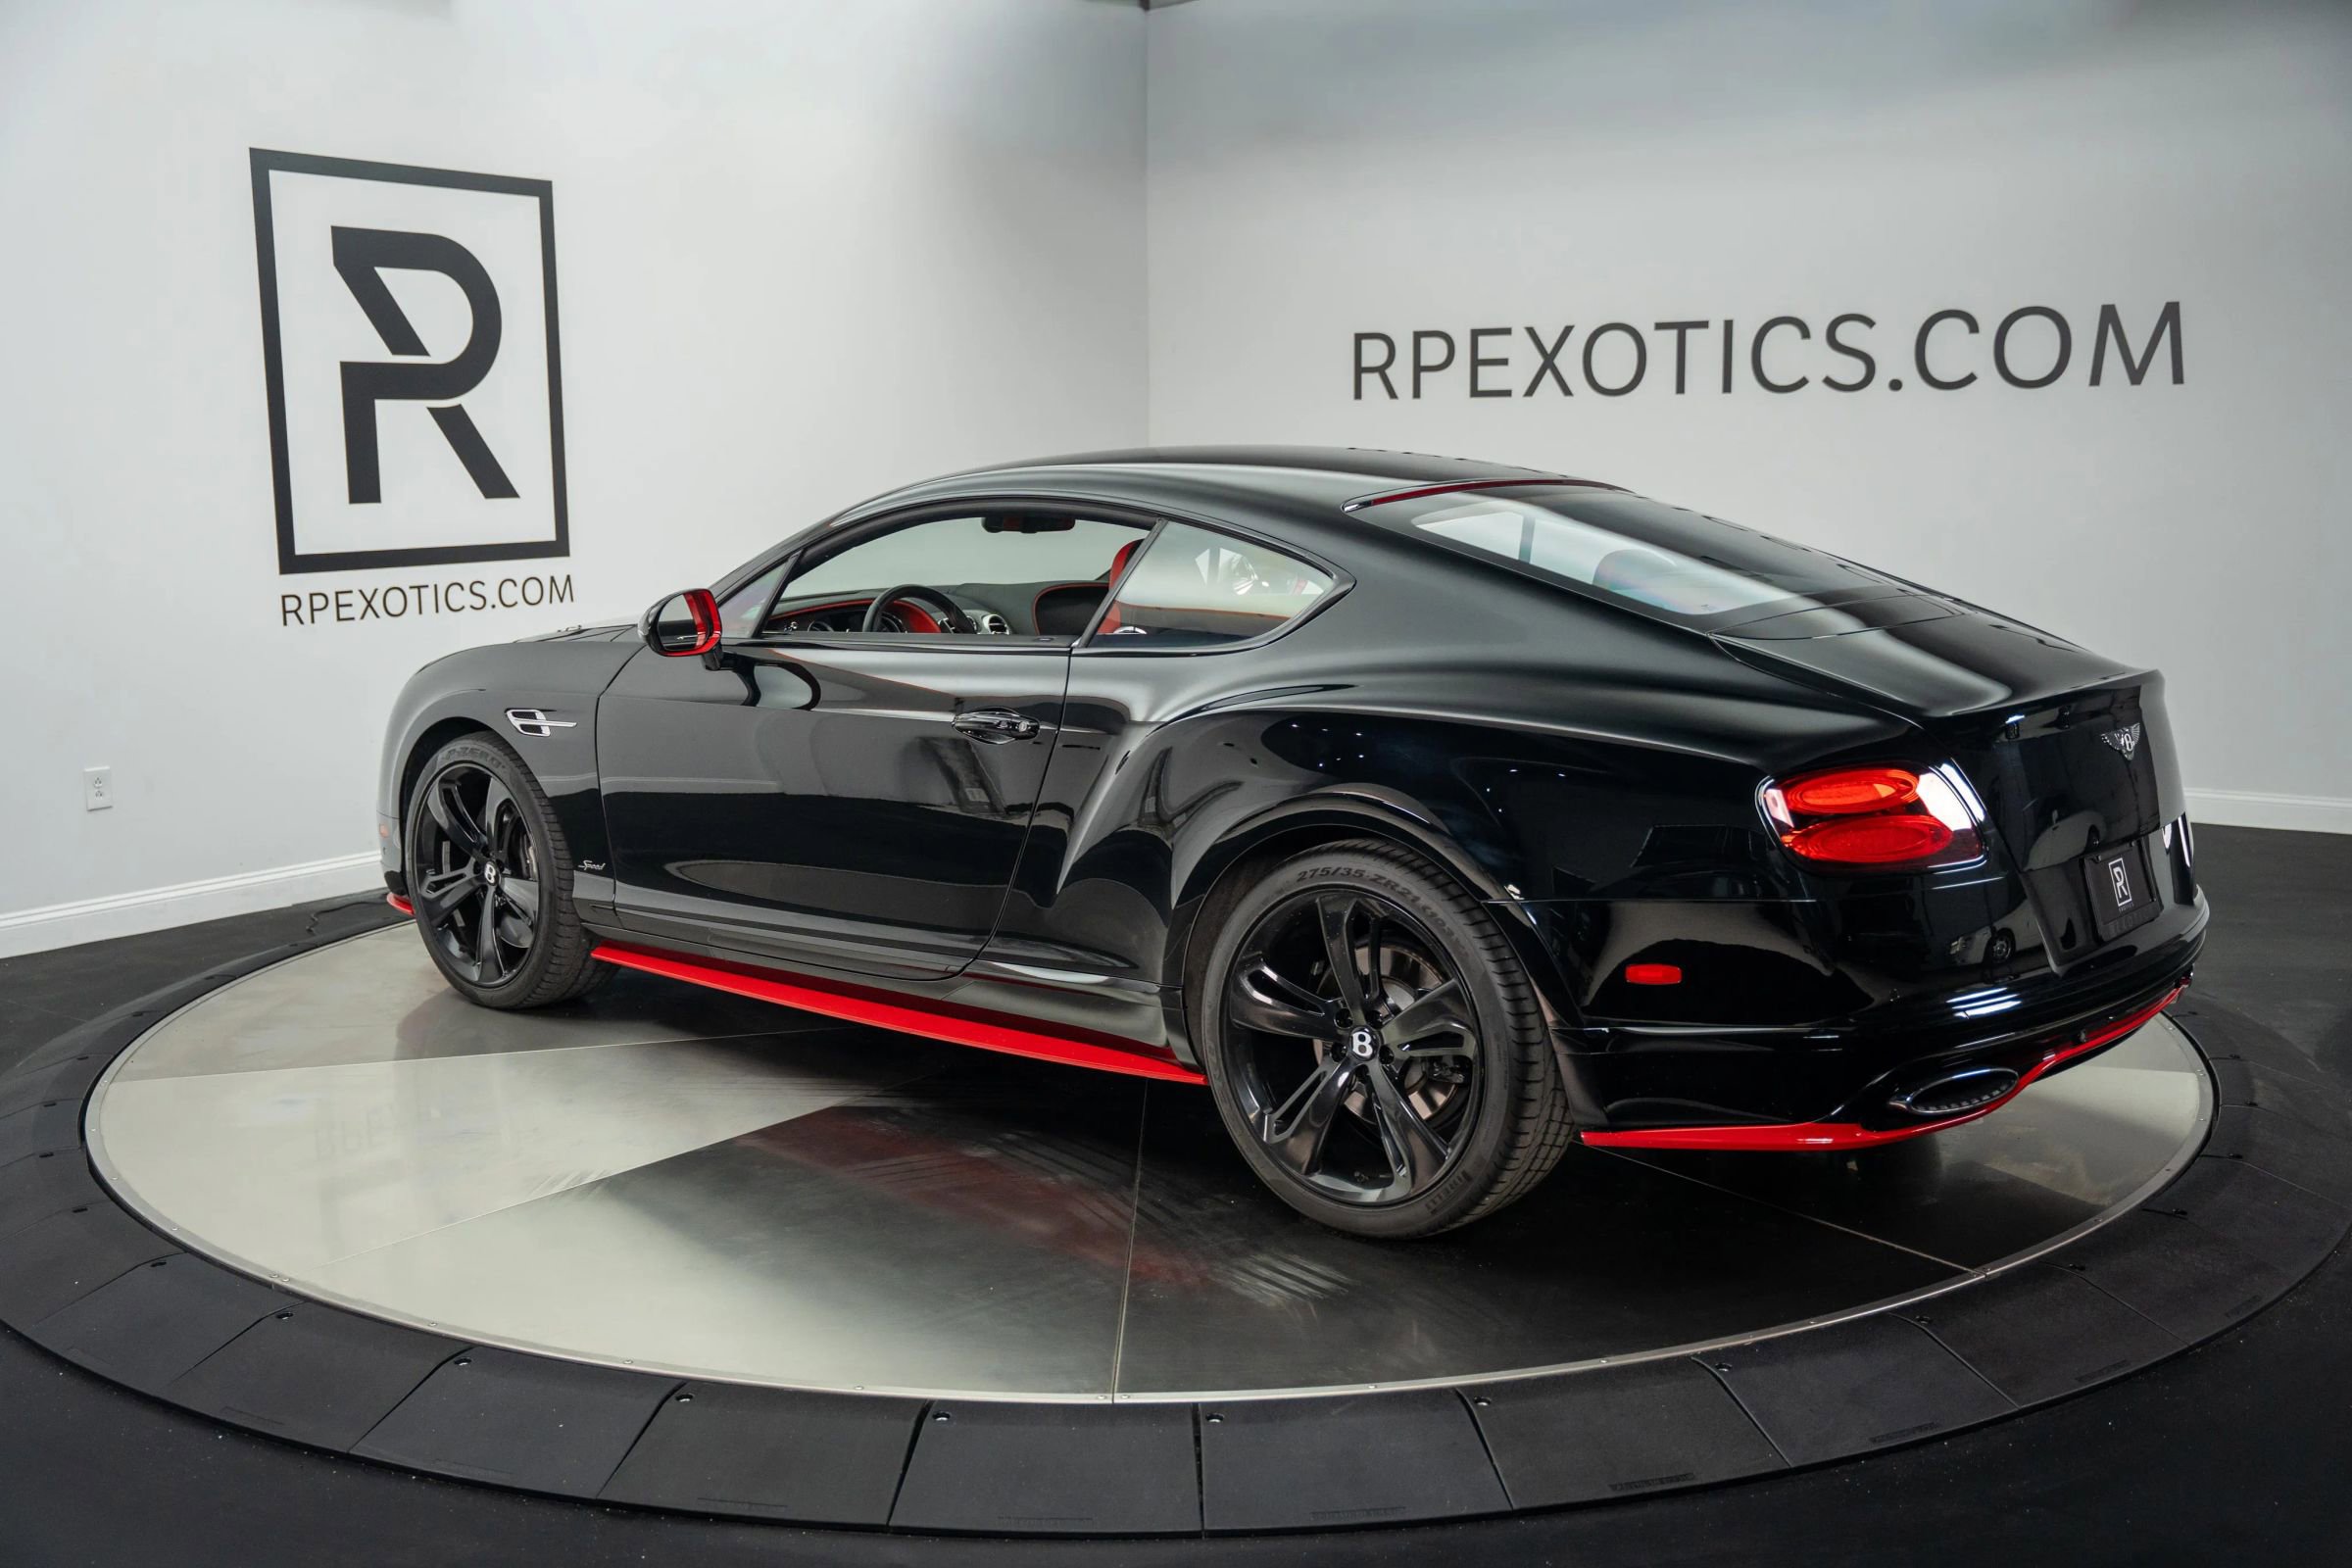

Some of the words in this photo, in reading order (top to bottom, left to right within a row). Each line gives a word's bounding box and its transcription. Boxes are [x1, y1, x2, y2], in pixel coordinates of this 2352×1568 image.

[1353, 301, 2184, 400] RPEXOTICS.COM
[280, 574, 574, 627] RPEXOTICS.COM
[1297, 866, 1366, 882] 275/35
[1352, 1031, 1373, 1056] B
